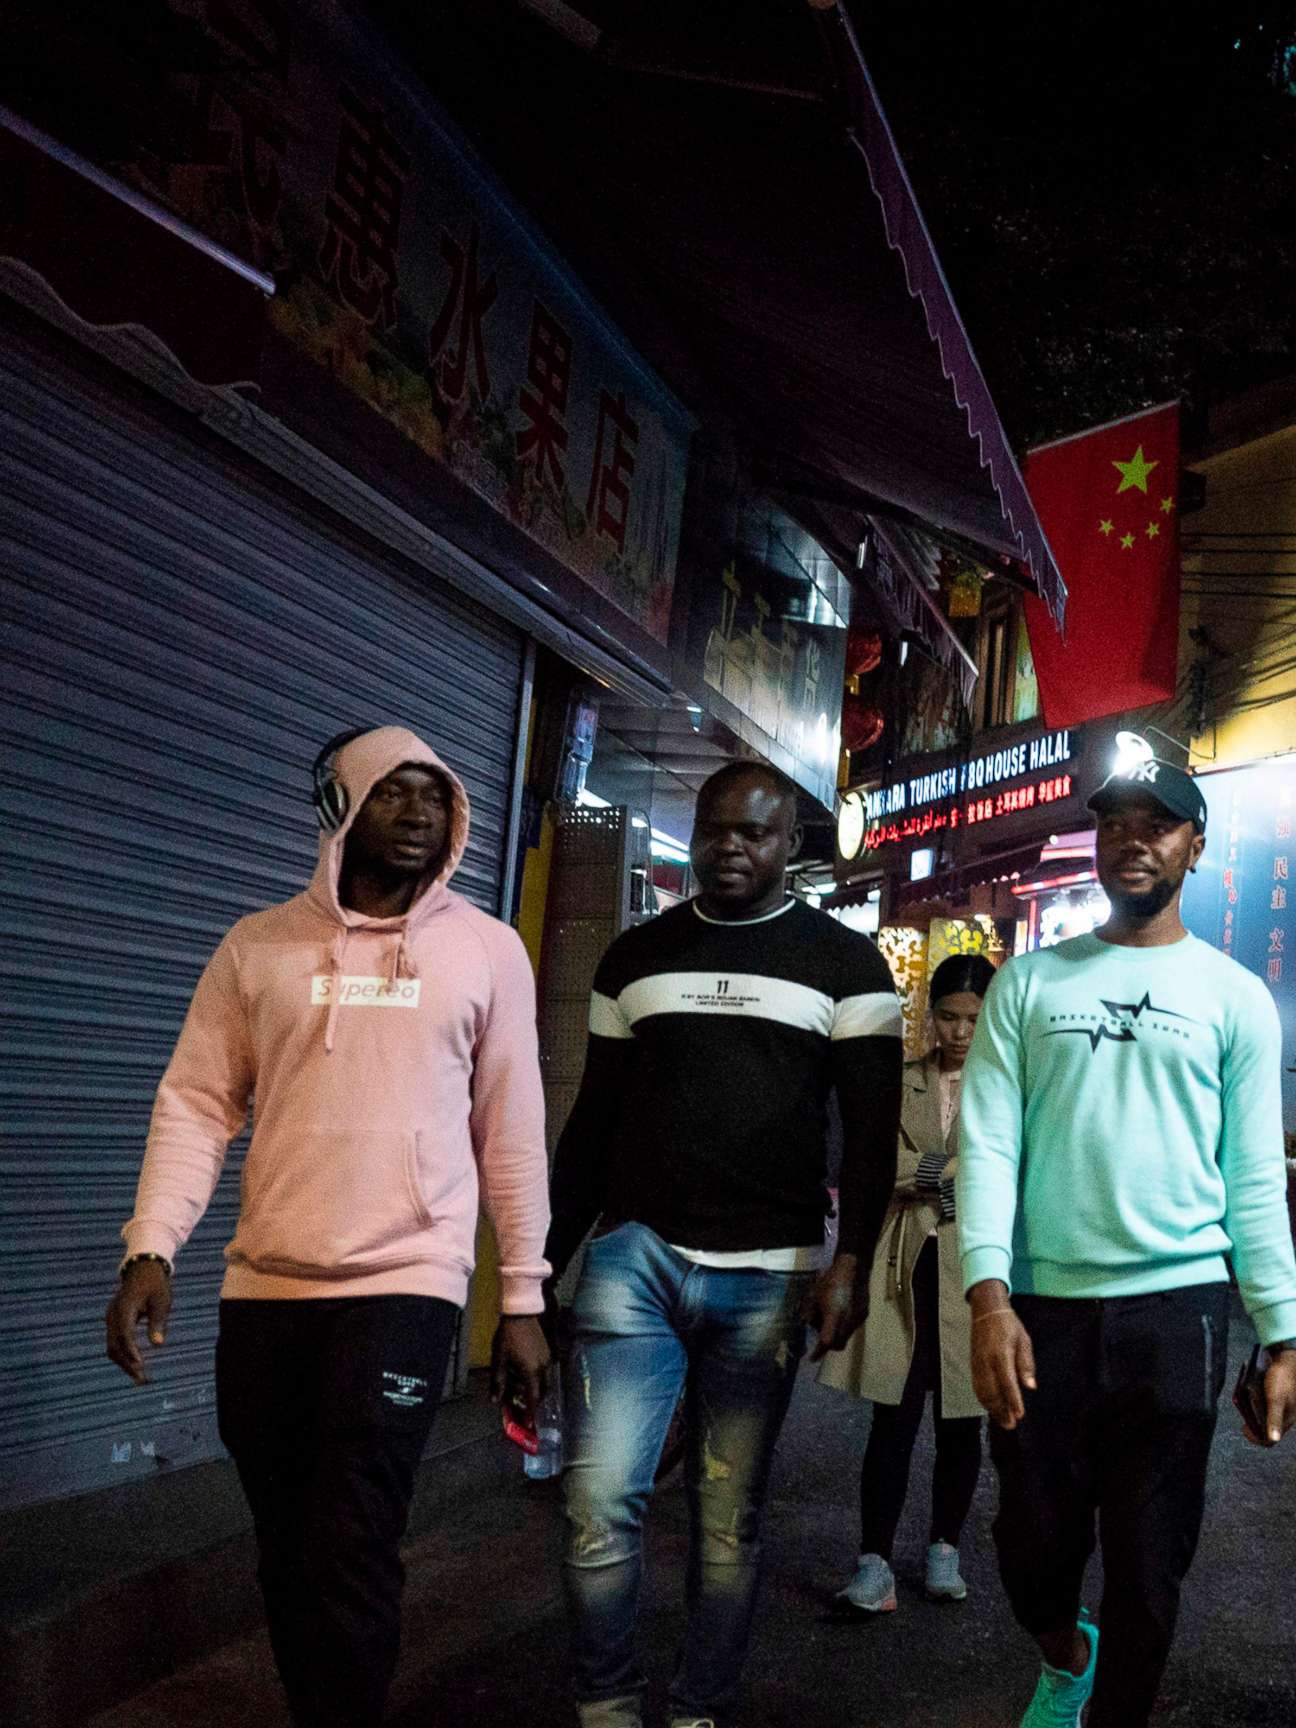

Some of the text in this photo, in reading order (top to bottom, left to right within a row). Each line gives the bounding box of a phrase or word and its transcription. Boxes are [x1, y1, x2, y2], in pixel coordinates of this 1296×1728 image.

[910, 767, 956, 807] TURKISH
[985, 744, 1026, 781] HOUSE
[1030, 730, 1071, 770] HALAL
[1271, 856, 1288, 910] 民主
[1267, 927, 1284, 982] 文明
[716, 979, 730, 994] 11
